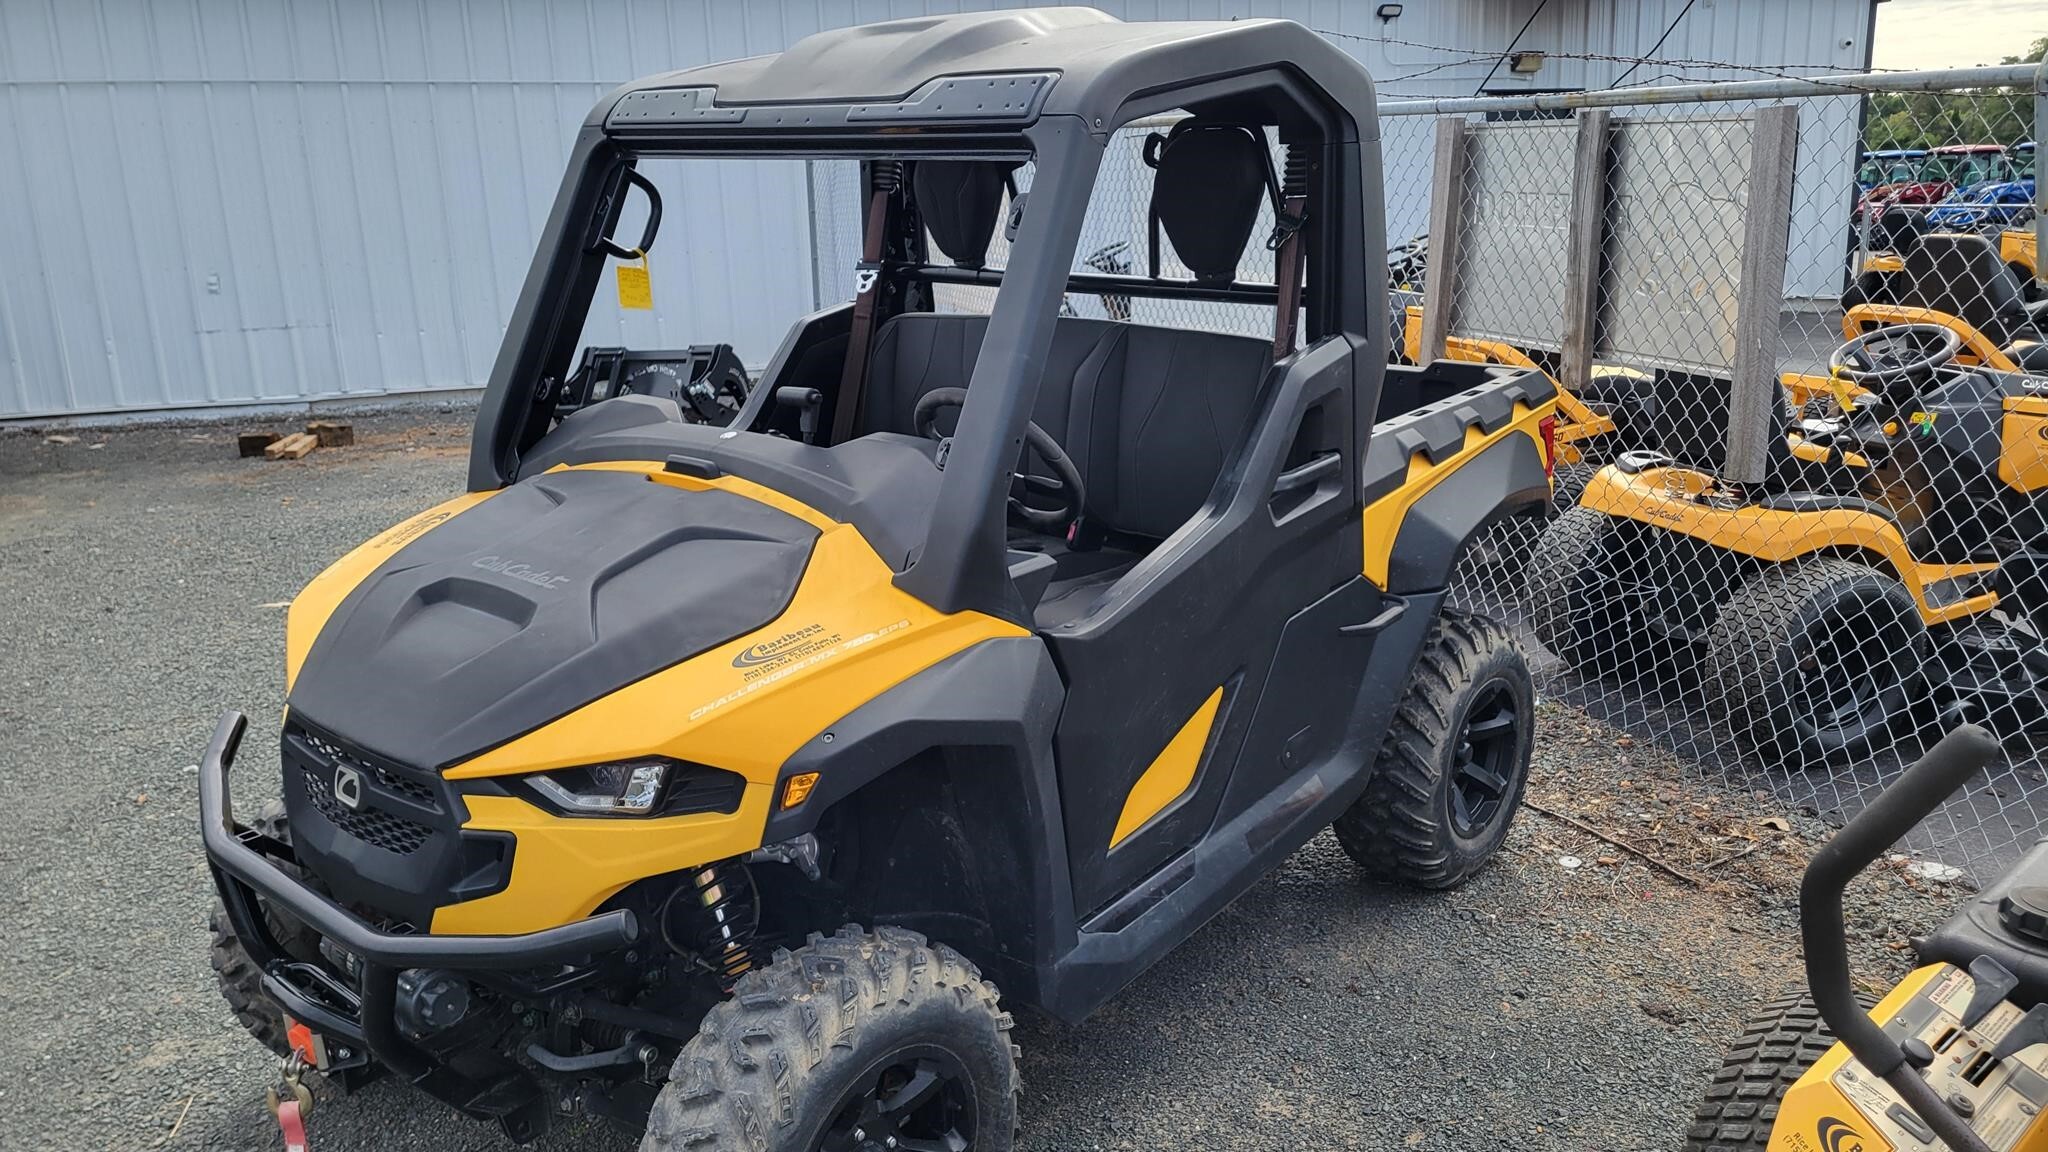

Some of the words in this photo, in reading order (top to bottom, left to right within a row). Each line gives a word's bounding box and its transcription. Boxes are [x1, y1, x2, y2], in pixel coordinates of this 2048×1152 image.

[471, 556, 513, 572] Cub
[502, 564, 571, 590] Cadet
[757, 623, 821, 652] Baribeau
[761, 636, 801, 656] Implement
[689, 661, 806, 720] CHALLENGER
[809, 650, 837, 664] MX
[1793, 1132, 1809, 1150] Rice
